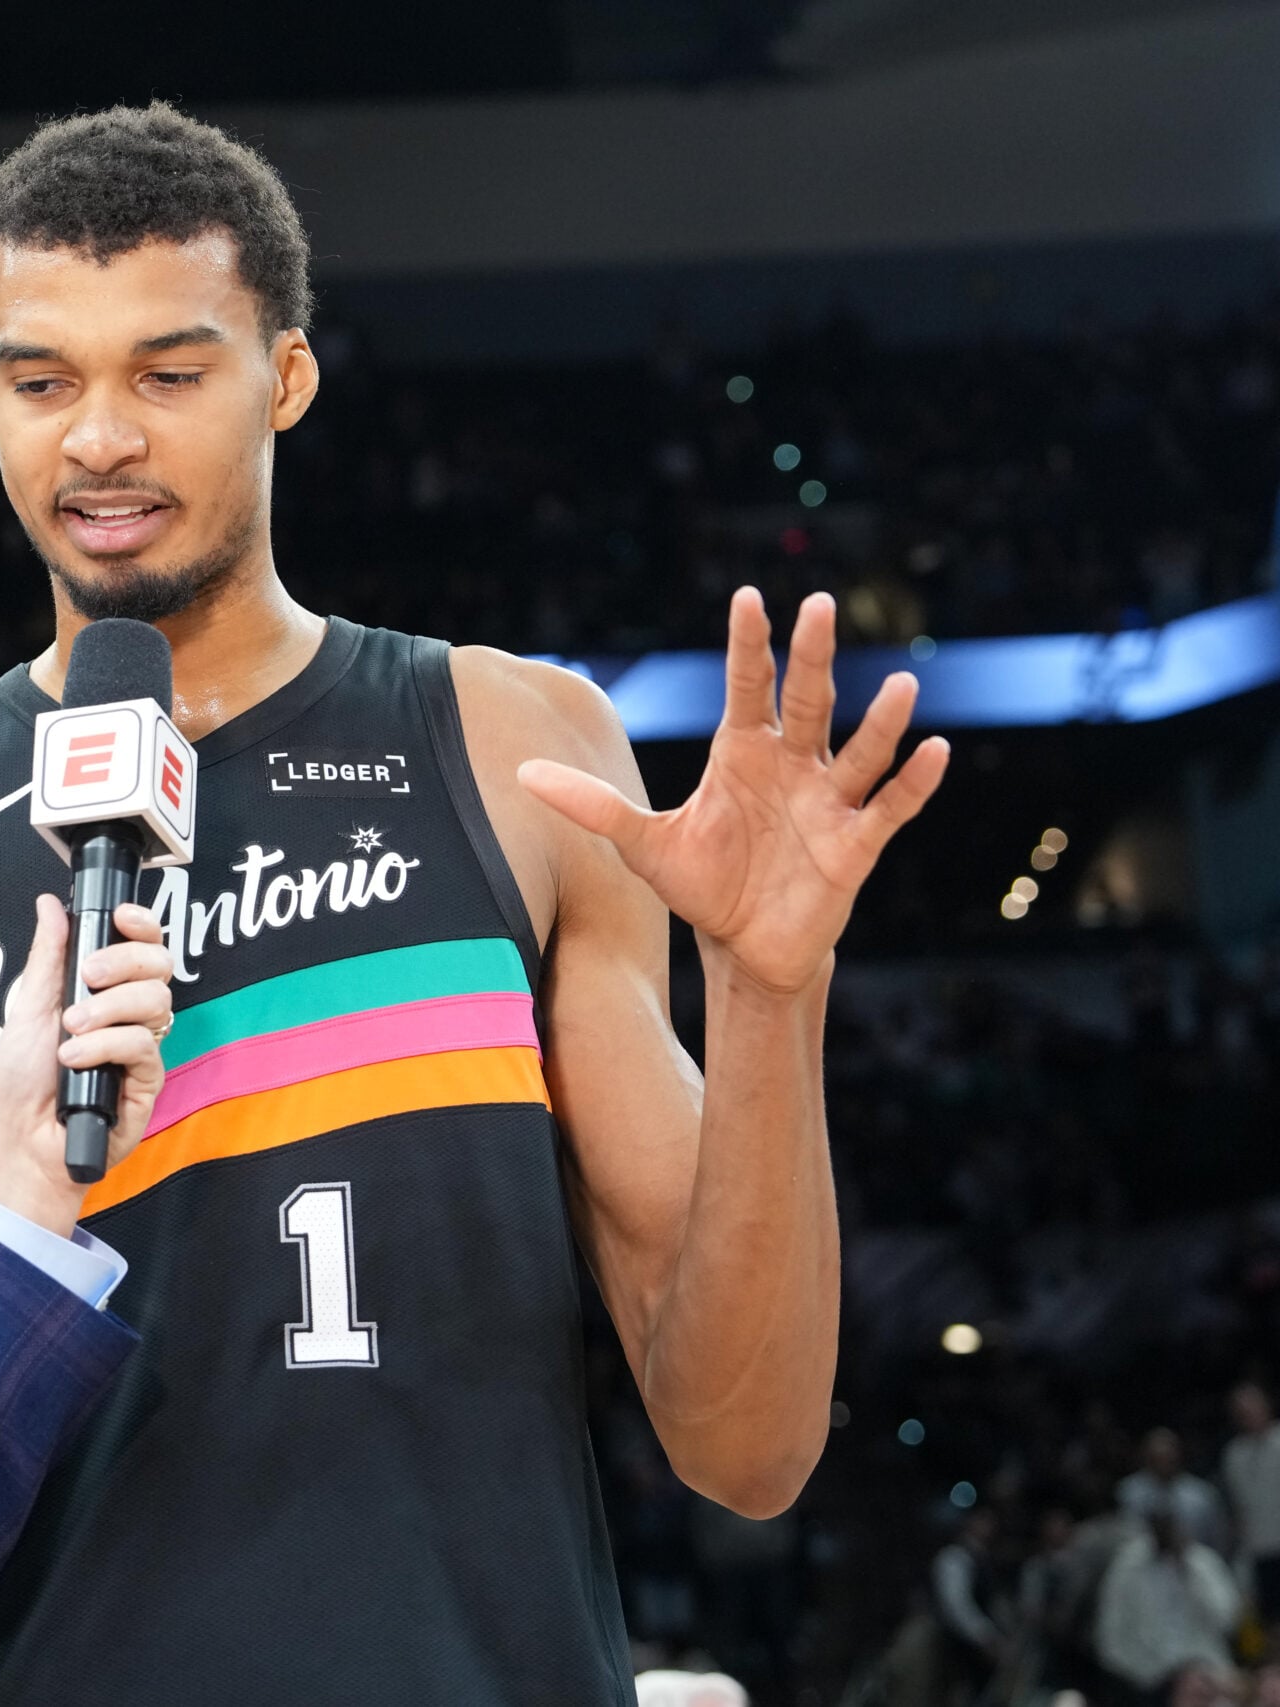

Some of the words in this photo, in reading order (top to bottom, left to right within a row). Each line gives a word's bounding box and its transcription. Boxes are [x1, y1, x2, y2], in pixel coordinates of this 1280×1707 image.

[62, 732, 116, 787] E
[287, 762, 391, 782] LEDGER
[150, 843, 420, 983] Antonio
[279, 1181, 380, 1369] 1
